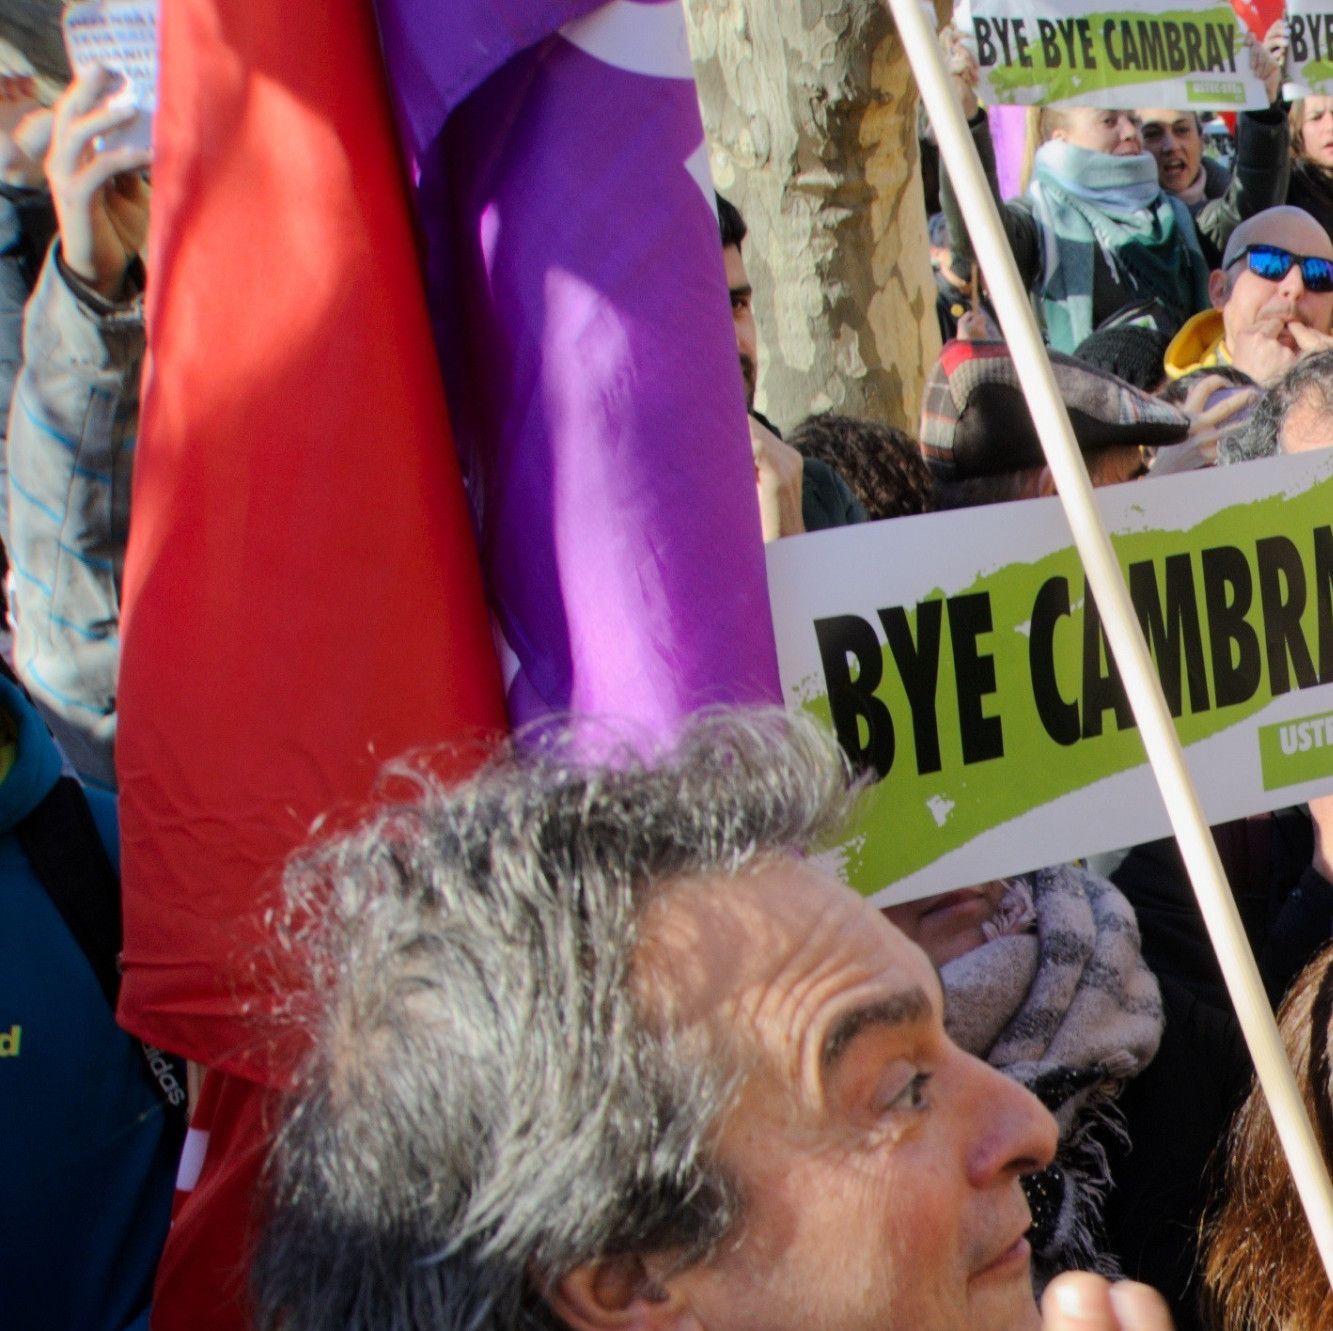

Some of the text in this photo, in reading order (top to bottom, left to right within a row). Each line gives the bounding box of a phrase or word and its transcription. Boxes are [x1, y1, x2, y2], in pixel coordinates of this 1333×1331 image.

[972, 16, 1237, 73] BYE BYE CAMBRAY
[814, 591, 1004, 788] BYE
